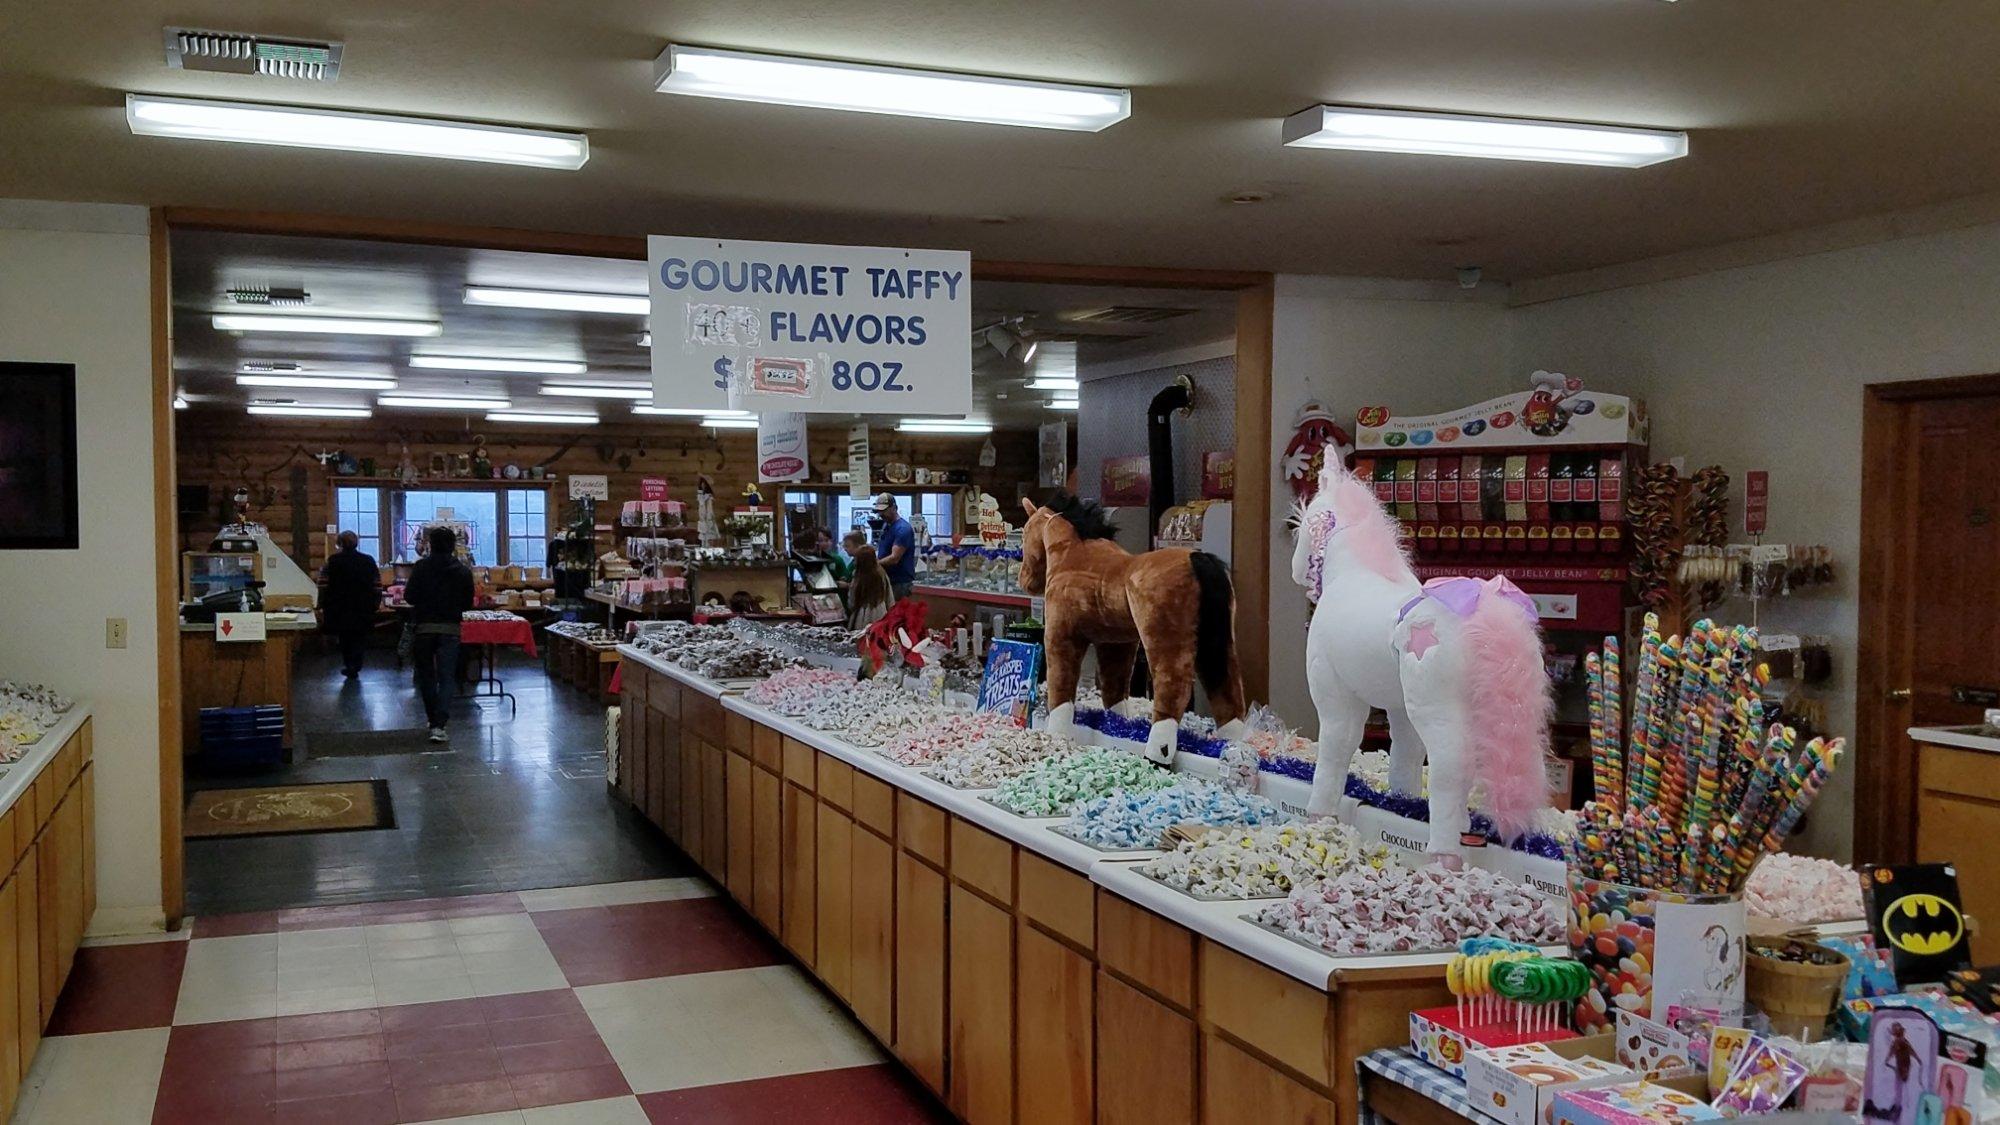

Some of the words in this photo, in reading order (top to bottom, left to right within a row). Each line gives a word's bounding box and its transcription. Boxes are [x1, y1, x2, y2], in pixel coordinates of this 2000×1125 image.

[660, 257, 850, 297] GOURMET
[866, 267, 963, 301] TAFFY
[770, 311, 927, 346] FLAVORS
[713, 354, 733, 392] $
[1407, 421, 1439, 430] ORIGINAL
[1441, 412, 1472, 426] GOURMET
[1474, 406, 1493, 418] JELLY
[982, 508, 995, 517] Hot
[1467, 567, 1517, 577] GOURMET
[1521, 568, 1550, 578] JELLY
[984, 674, 1021, 714] TREATS
[1381, 829, 1424, 853] CHOCOLATE
